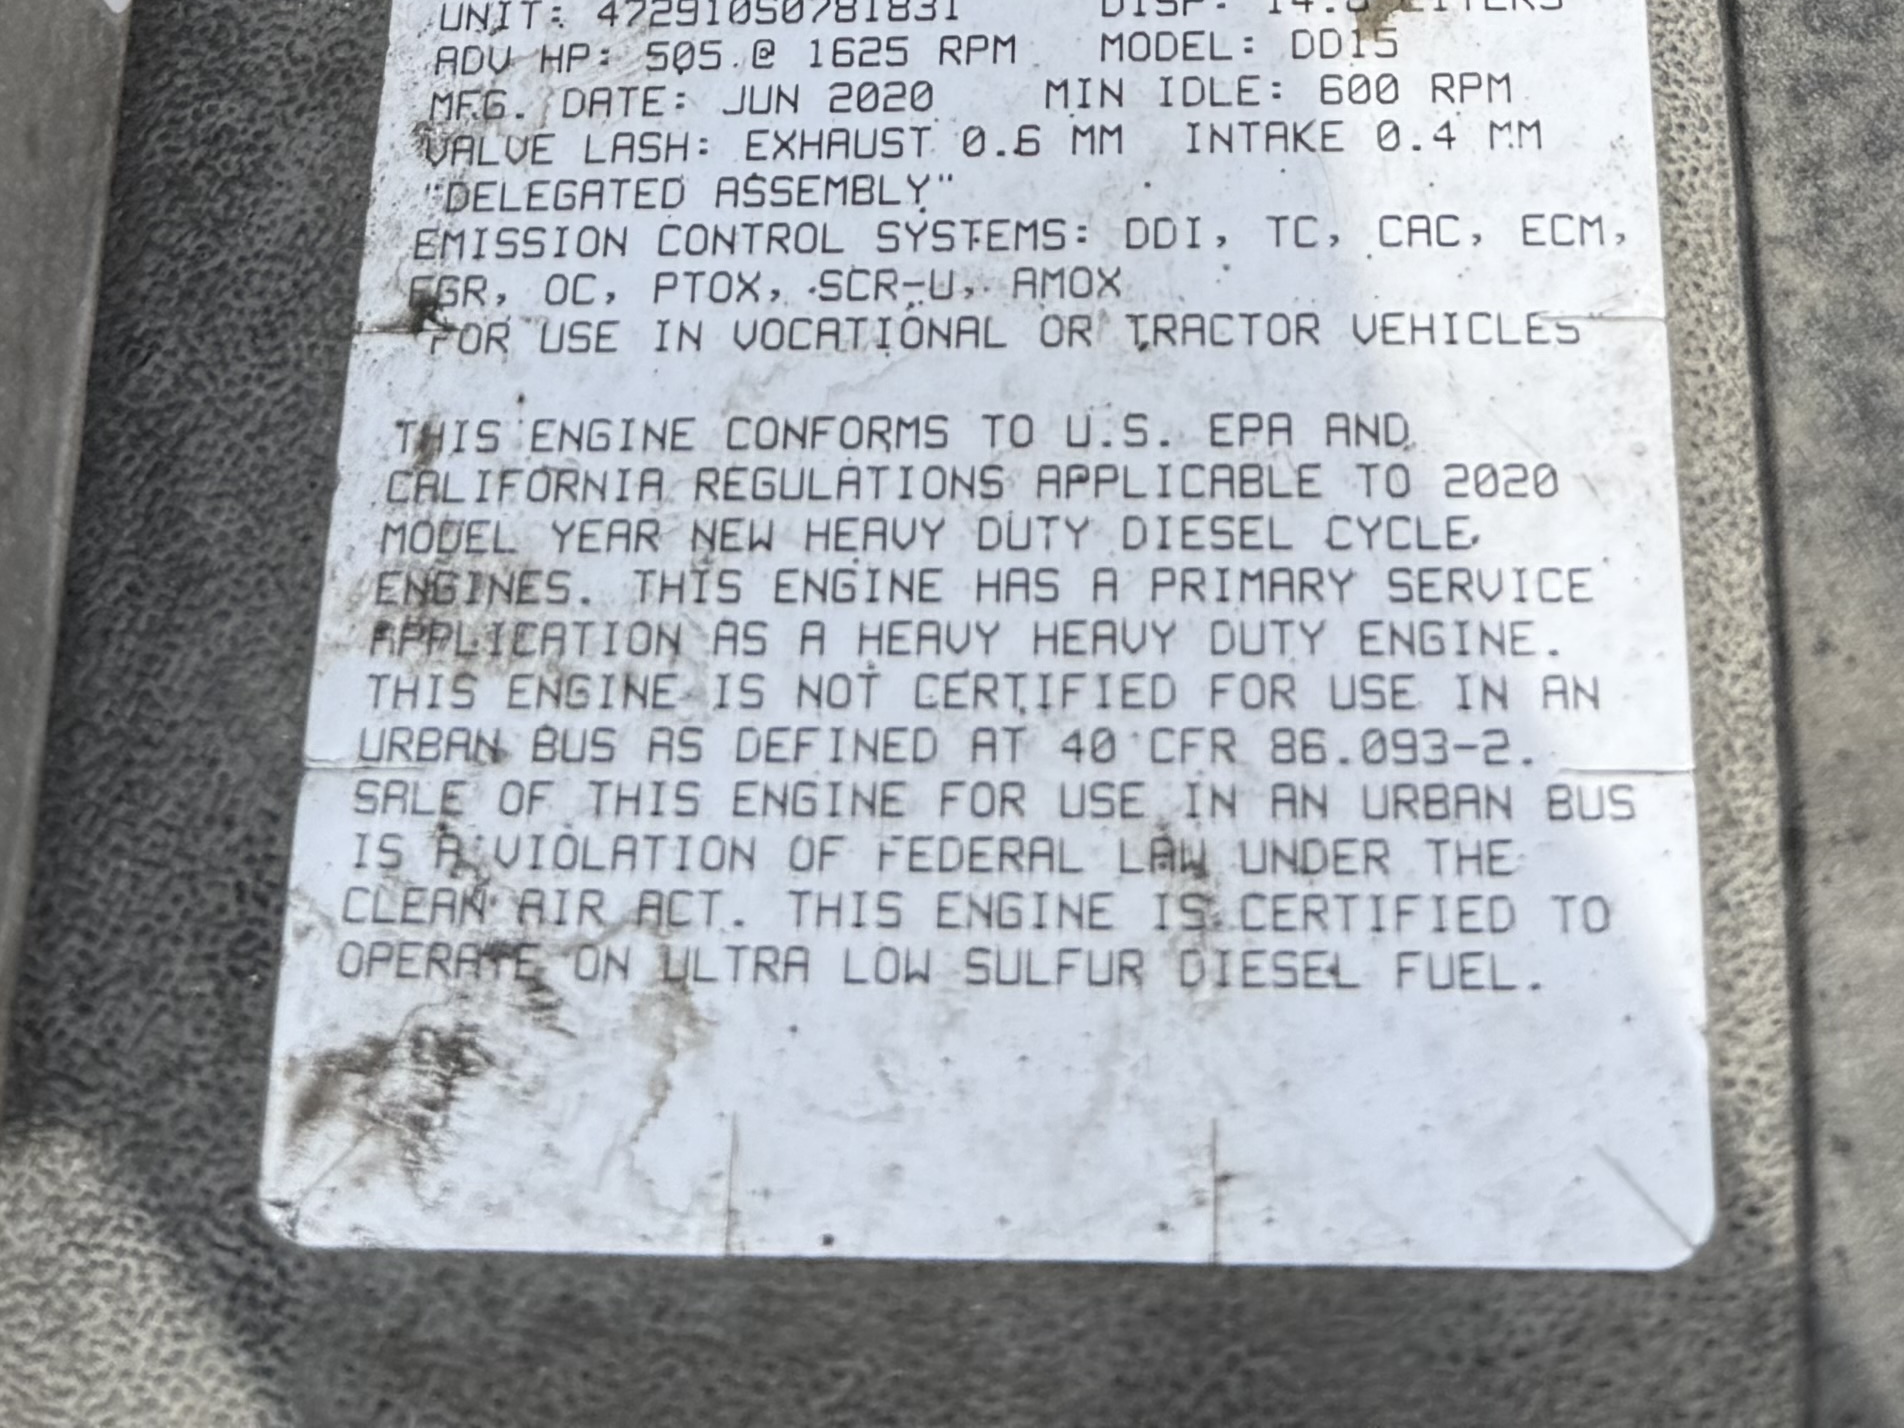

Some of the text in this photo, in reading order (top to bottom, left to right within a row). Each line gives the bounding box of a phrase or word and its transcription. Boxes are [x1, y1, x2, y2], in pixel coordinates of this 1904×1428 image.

[433, 26, 1399, 76] ADV HP: @ 1625 RPM MODEL: DD15
[561, 71, 1512, 119] DATE: JUN 2020 MIN IDLE: 600 RPM
[583, 118, 1543, 165] LASH: EXHAUST 0.6 MM INTAKE 0.4 MM
[714, 172, 954, 209] ASSEMBLY"
[412, 212, 1627, 260] EMISSION CONTROL SYSTEMS: DDI, TC, CAC, ECM,
[543, 264, 1122, 307] OC, PTOX, AMOX
[539, 311, 1320, 355] USE IN VOCATIONAL OR TRACTOR
[529, 411, 1294, 454] ENGINE CONFORMS TO U.S. EPA
[385, 461, 1560, 503] CALIFORNIA REGULATIONS APPLICABLE TO 2020
[550, 514, 1294, 555] YEAR NEW HEAVY DUTY DIESEL
[633, 565, 1594, 606] THIS ENGINE HAS A PRIMARY SERVICE
[712, 618, 1559, 658] AS A HEAVY HEAVY DUTY ENGINE.
[367, 670, 1601, 713] THIS ENGINE IS NOT CERTIFIED FOR USE IN AN
[357, 722, 1533, 767] URBAN BUS AS DEFINED AT 40 CFR 86.093-2.
[353, 778, 1636, 822] SALE OF THIS ENGINE FOR USE IN AN URBAN BUS
[353, 831, 1514, 877] IS VIOLATION OF FEDERAL UNDER THE
[515, 887, 1611, 935] AIR ACT. THIS ENGINE IS CERTIFIED TO
[573, 940, 1541, 992] ON LOW SULFUR DIESEL FUEL.
